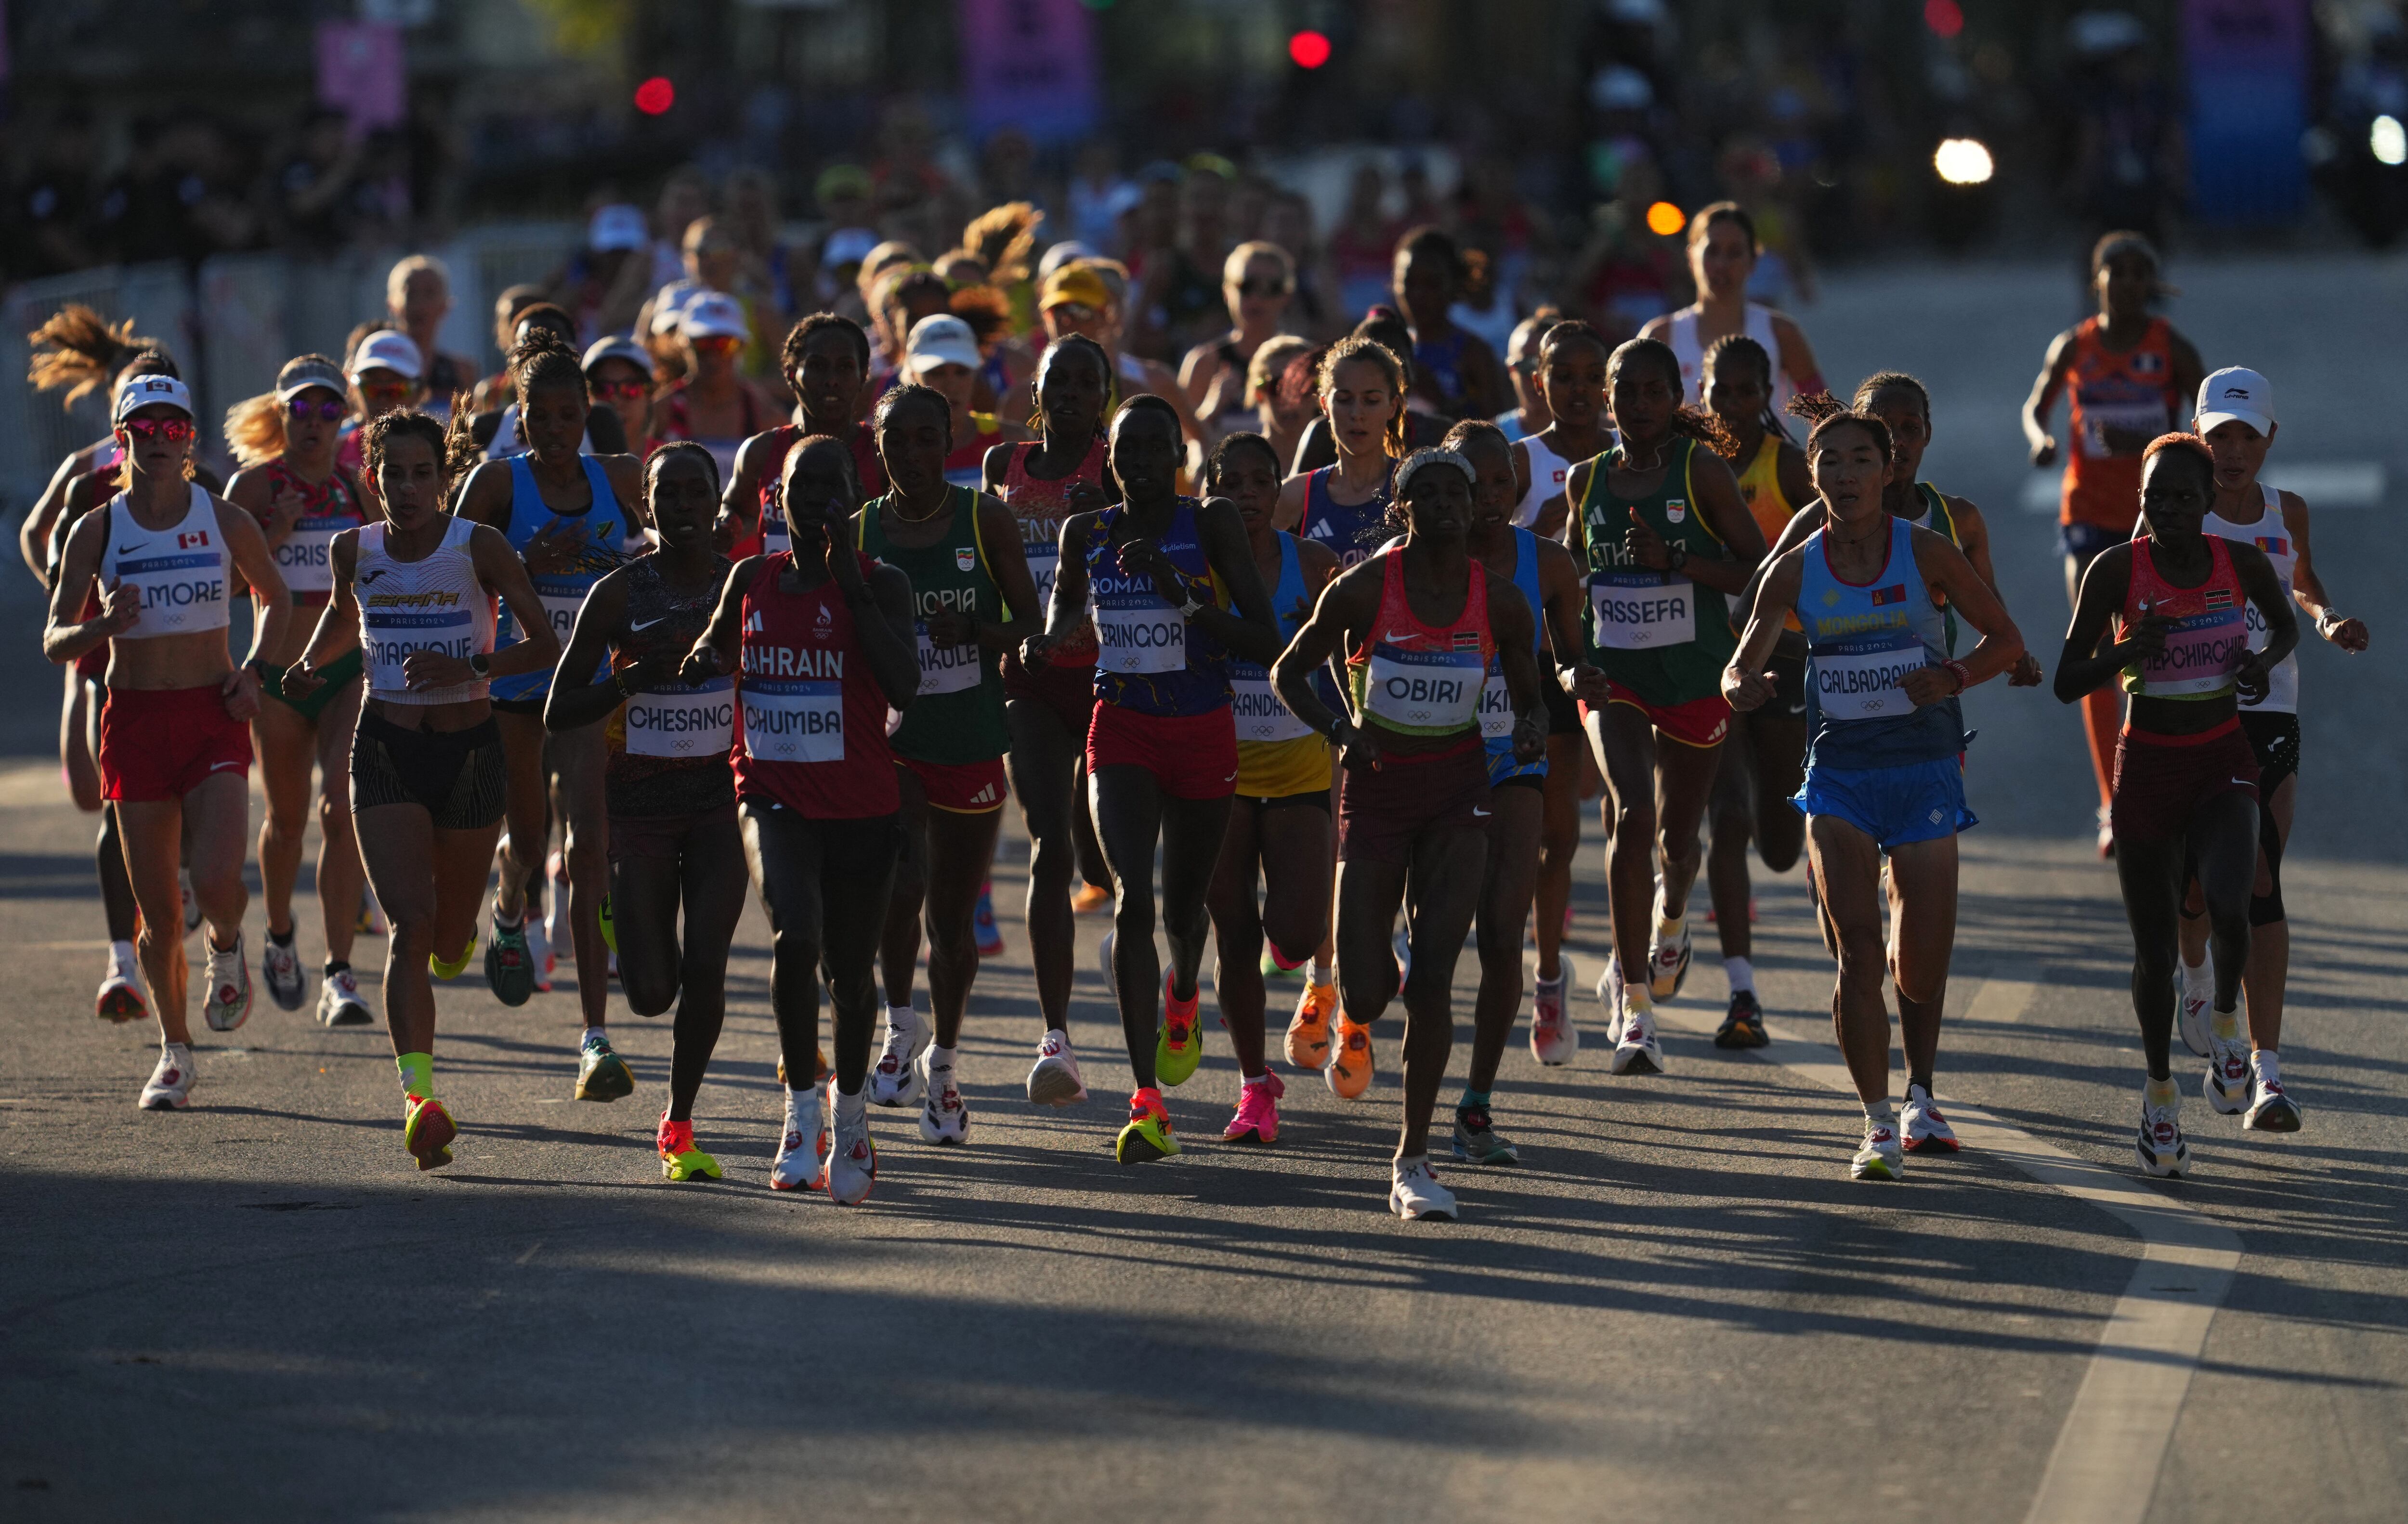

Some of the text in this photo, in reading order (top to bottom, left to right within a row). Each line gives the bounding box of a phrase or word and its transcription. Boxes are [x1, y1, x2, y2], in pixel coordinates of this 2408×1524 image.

[277, 544, 329, 566] CRIS
[1167, 542, 1196, 552] atletism
[142, 557, 196, 570] PARIS 2024
[140, 580, 222, 609] MORE
[366, 590, 459, 607] ESPAÑA
[540, 586, 567, 594] PARIS
[1601, 598, 1685, 624] ASSEFA
[2199, 616, 2224, 625] 2024
[1817, 610, 1909, 637] MONGOLIA
[1867, 642, 1893, 651] 2024
[741, 645, 844, 678] BAHRAIN
[1401, 653, 1457, 664] PARIS 2024
[759, 683, 782, 691] PARIS
[1386, 677, 1463, 703] OBIRI
[628, 703, 733, 732] CHESANG
[746, 706, 841, 735] CHUMBA
